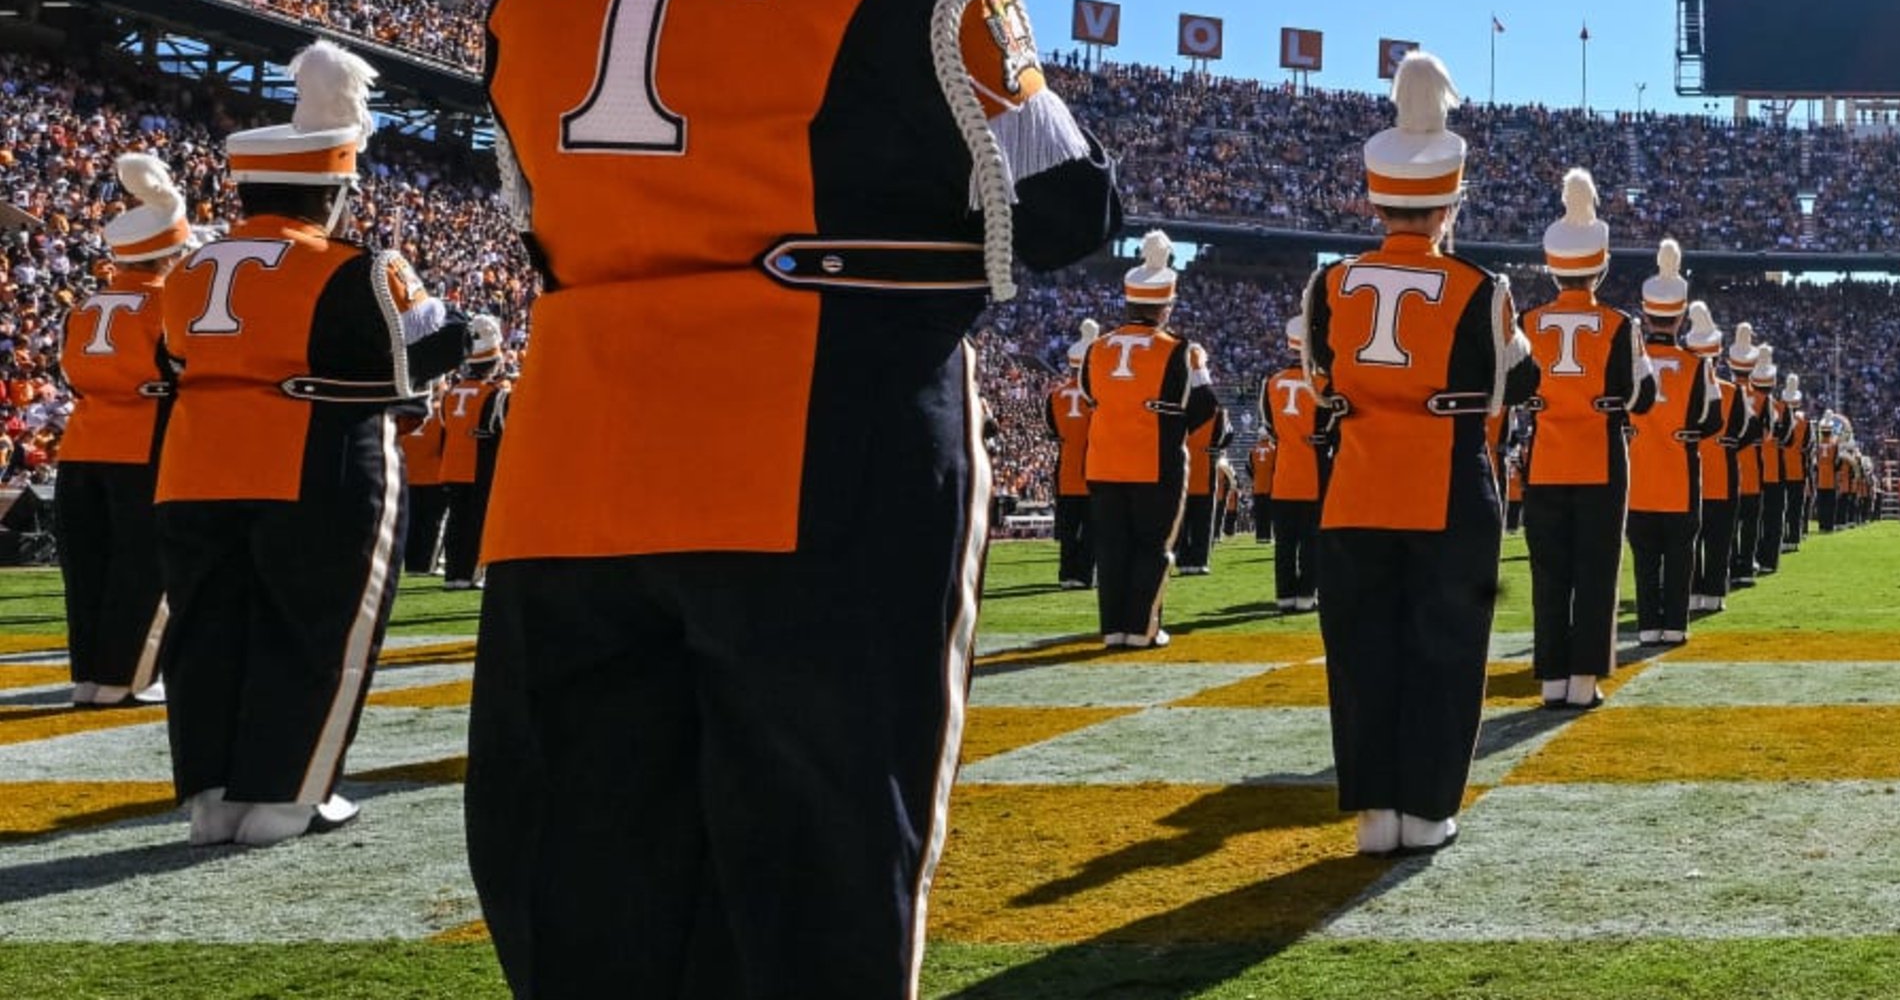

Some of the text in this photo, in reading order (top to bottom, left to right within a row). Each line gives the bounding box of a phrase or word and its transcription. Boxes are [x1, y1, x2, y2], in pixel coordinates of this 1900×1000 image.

[185, 238, 294, 336] T
[80, 292, 148, 355] T
[1339, 263, 1450, 368] T
[1105, 333, 1154, 380] T
[1537, 312, 1602, 377] T
[451, 387, 479, 417] T
[1060, 388, 1084, 417] T
[1276, 379, 1309, 416] T
